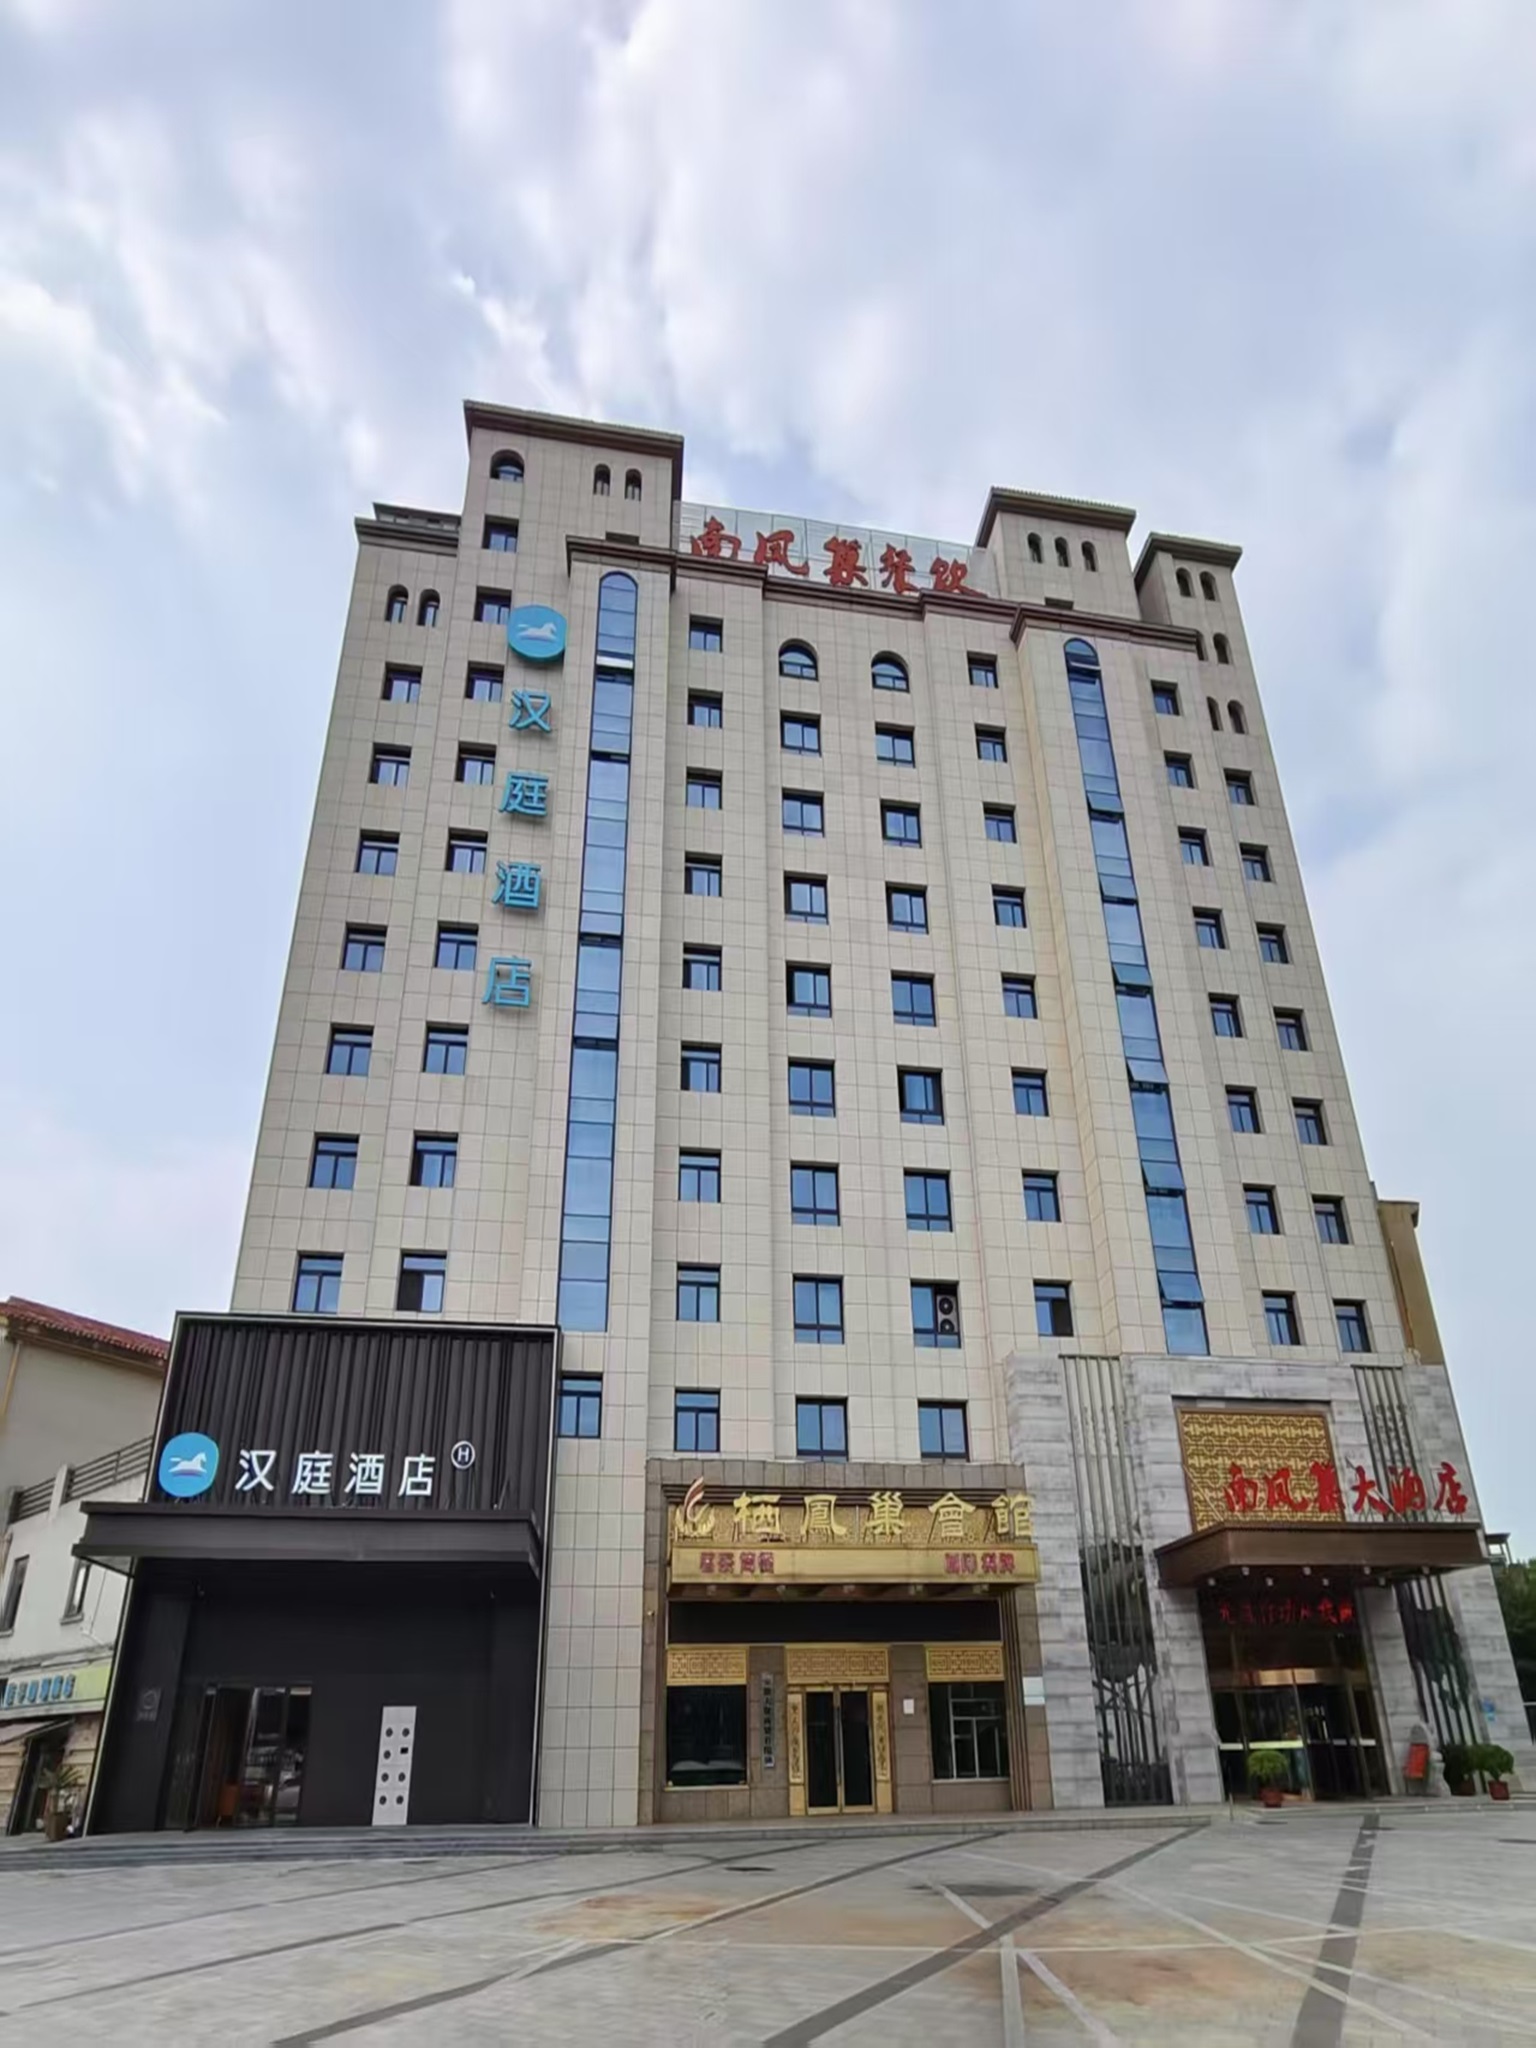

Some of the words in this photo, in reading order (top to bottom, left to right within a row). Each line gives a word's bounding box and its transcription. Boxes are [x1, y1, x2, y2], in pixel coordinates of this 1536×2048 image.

[482, 688, 552, 1009] 汉庭酒店
[235, 1450, 436, 1496] 汉庭酒店
